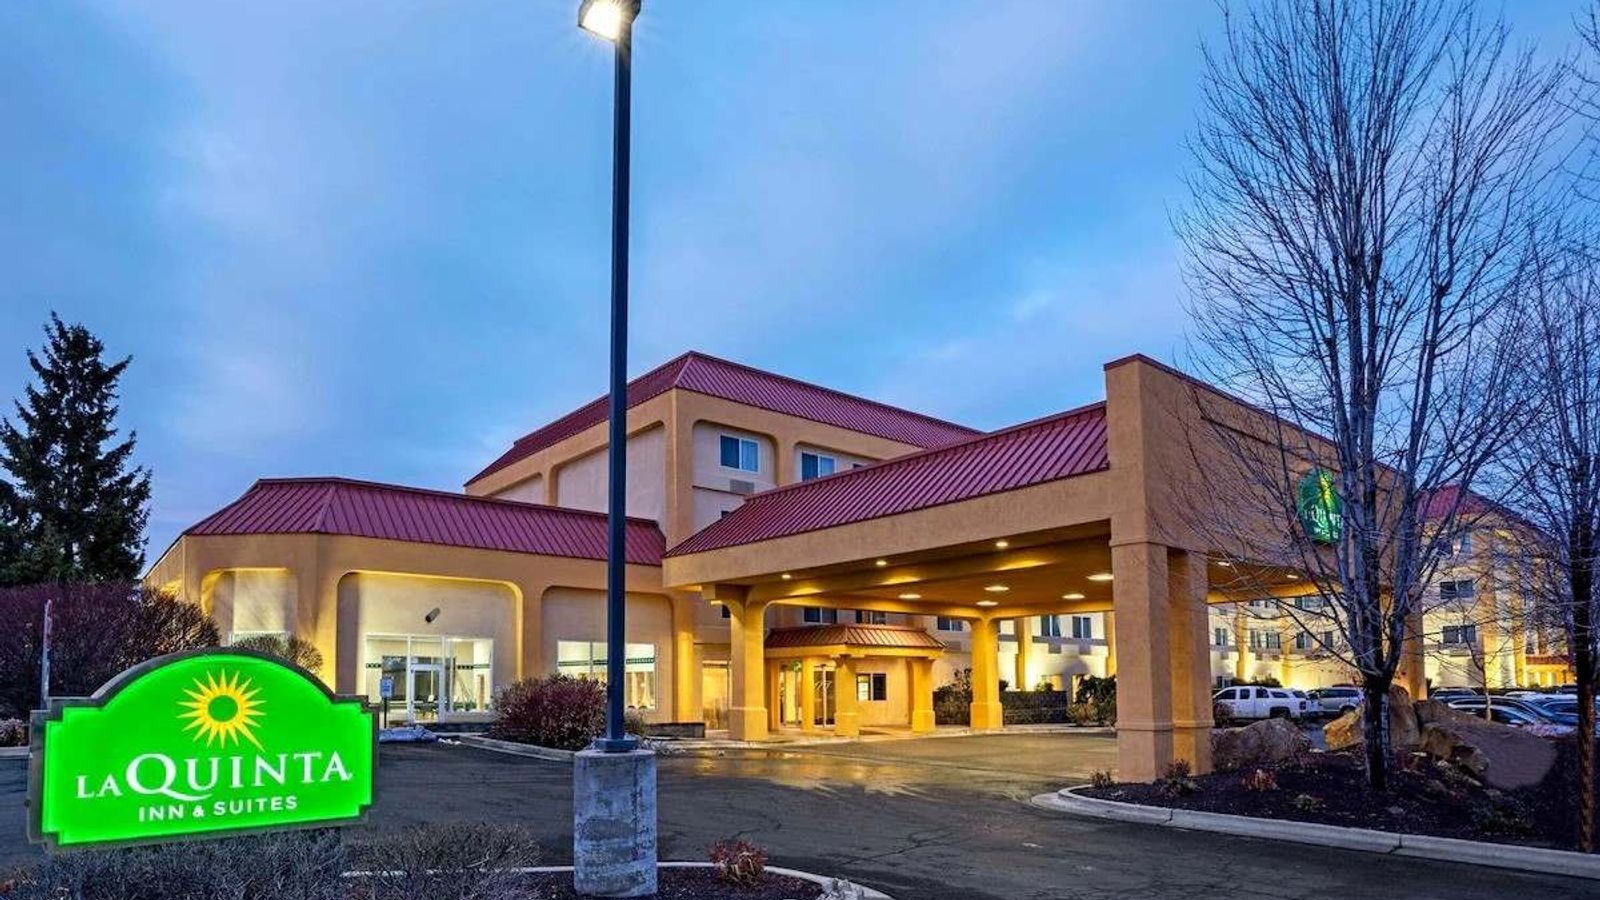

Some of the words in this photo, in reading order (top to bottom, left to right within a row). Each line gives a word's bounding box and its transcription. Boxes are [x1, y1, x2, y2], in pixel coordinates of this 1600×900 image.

[77, 774, 122, 799] LA
[126, 751, 349, 801] QUINTA
[139, 805, 184, 821] INN
[192, 804, 205, 818] &
[214, 796, 298, 816] SUITES
